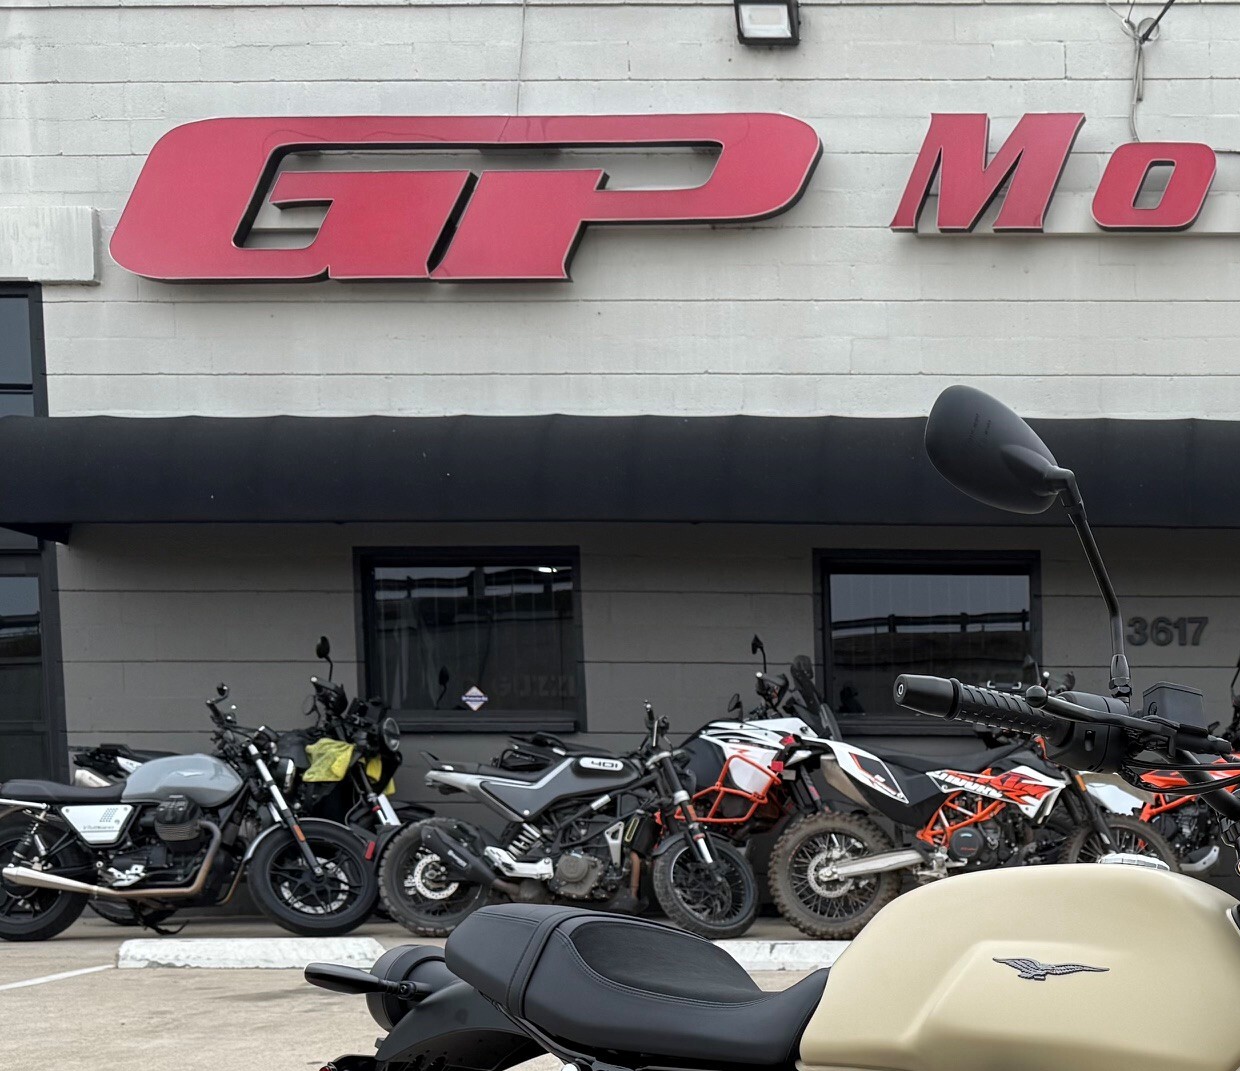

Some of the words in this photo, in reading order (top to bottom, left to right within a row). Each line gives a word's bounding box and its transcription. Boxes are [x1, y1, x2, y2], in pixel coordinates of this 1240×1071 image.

[108, 113, 823, 284] GP
[1126, 616, 1209, 647] 3617
[590, 759, 619, 768] 401
